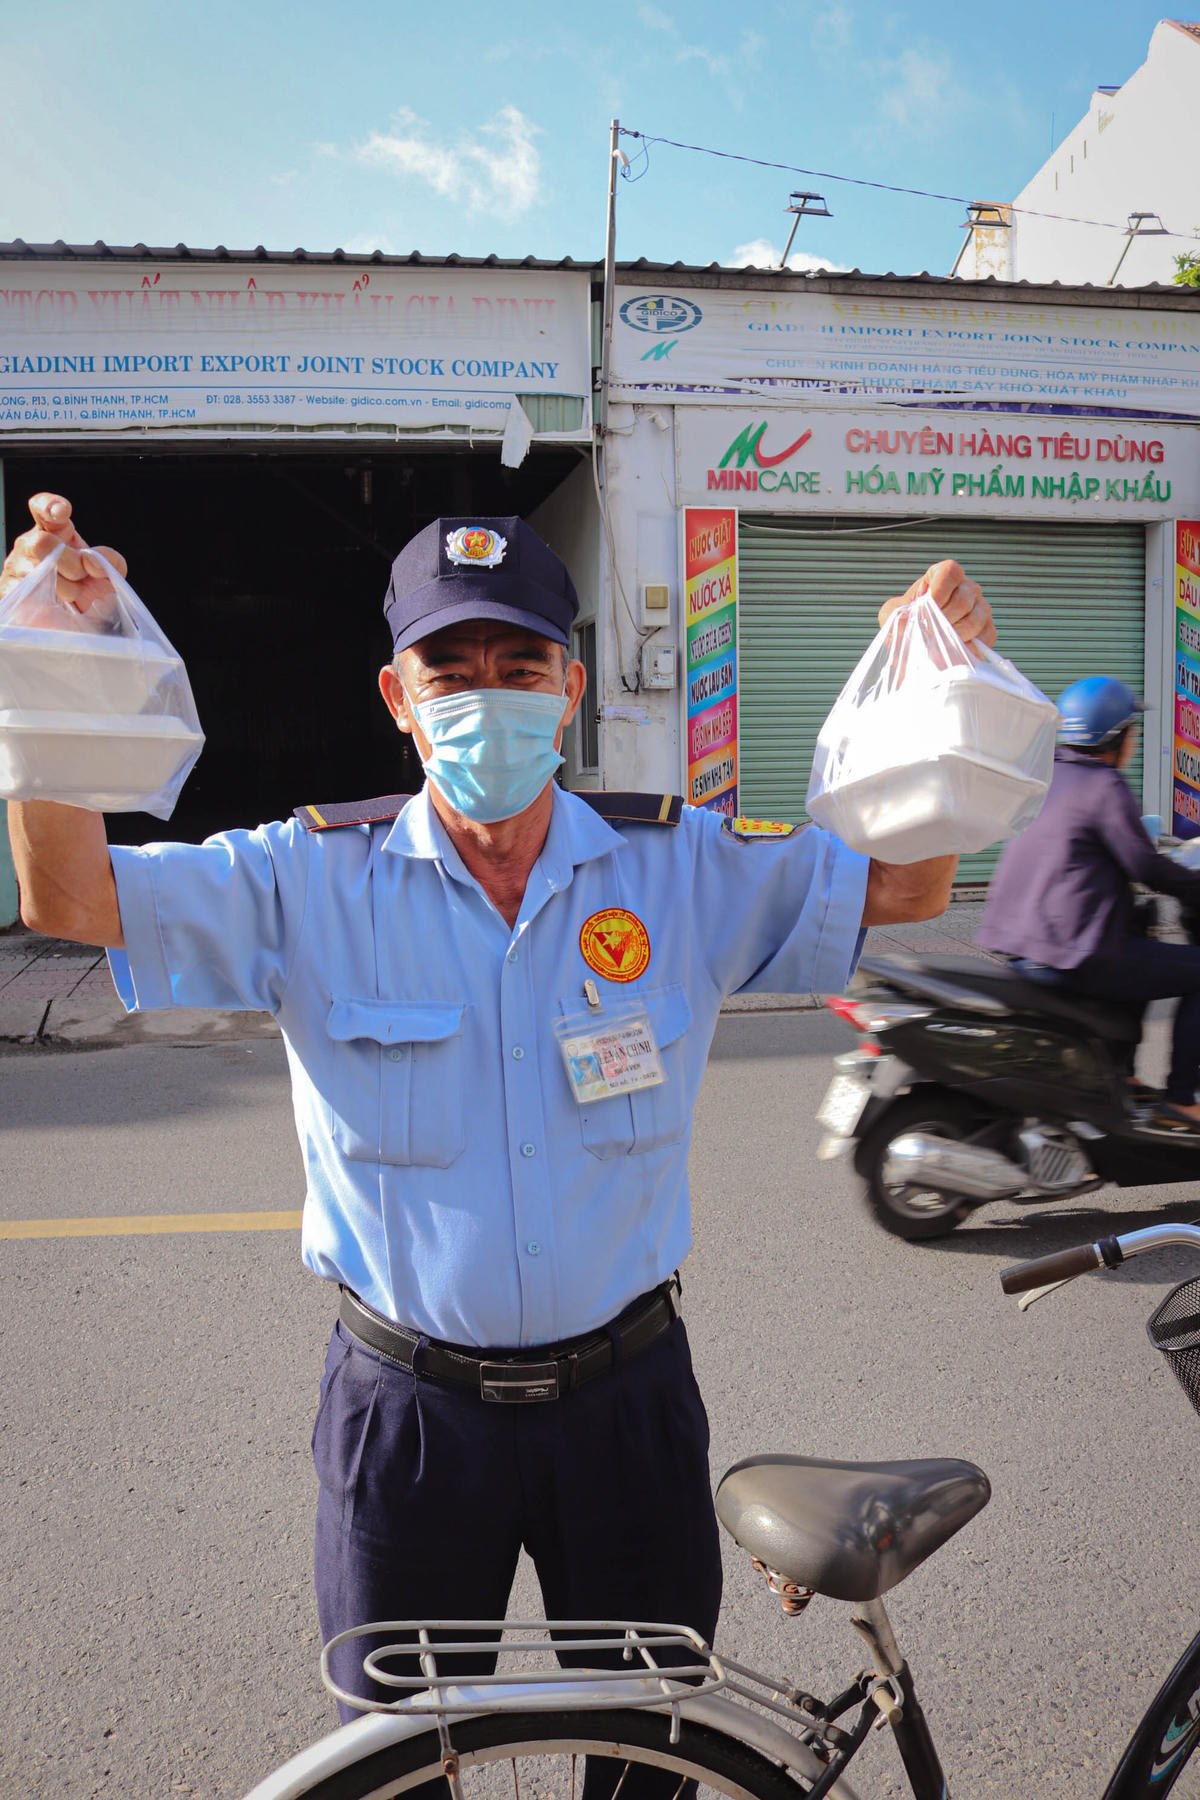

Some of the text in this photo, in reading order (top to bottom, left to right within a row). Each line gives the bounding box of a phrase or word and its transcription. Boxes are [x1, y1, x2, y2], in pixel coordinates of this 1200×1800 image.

[840, 325, 913, 337] IMPORT
[921, 328, 996, 341] EXPORT
[1001, 332, 1054, 346] JOINT
[1060, 336, 1121, 349] STOCK
[104, 355, 193, 373] IMPORT
[200, 355, 291, 373] EXPORT
[297, 356, 365, 374] JOINT
[372, 357, 445, 377] STOCK
[452, 359, 560, 379] COMPANY
[868, 361, 919, 373] DOANH
[845, 425, 1165, 463] CHUYÊN HÀNG TIÊU DÙNG
[707, 469, 821, 493] MINICARE
[846, 464, 1172, 504] HÓA MỸ PHẨM NHẬP KHẨU
